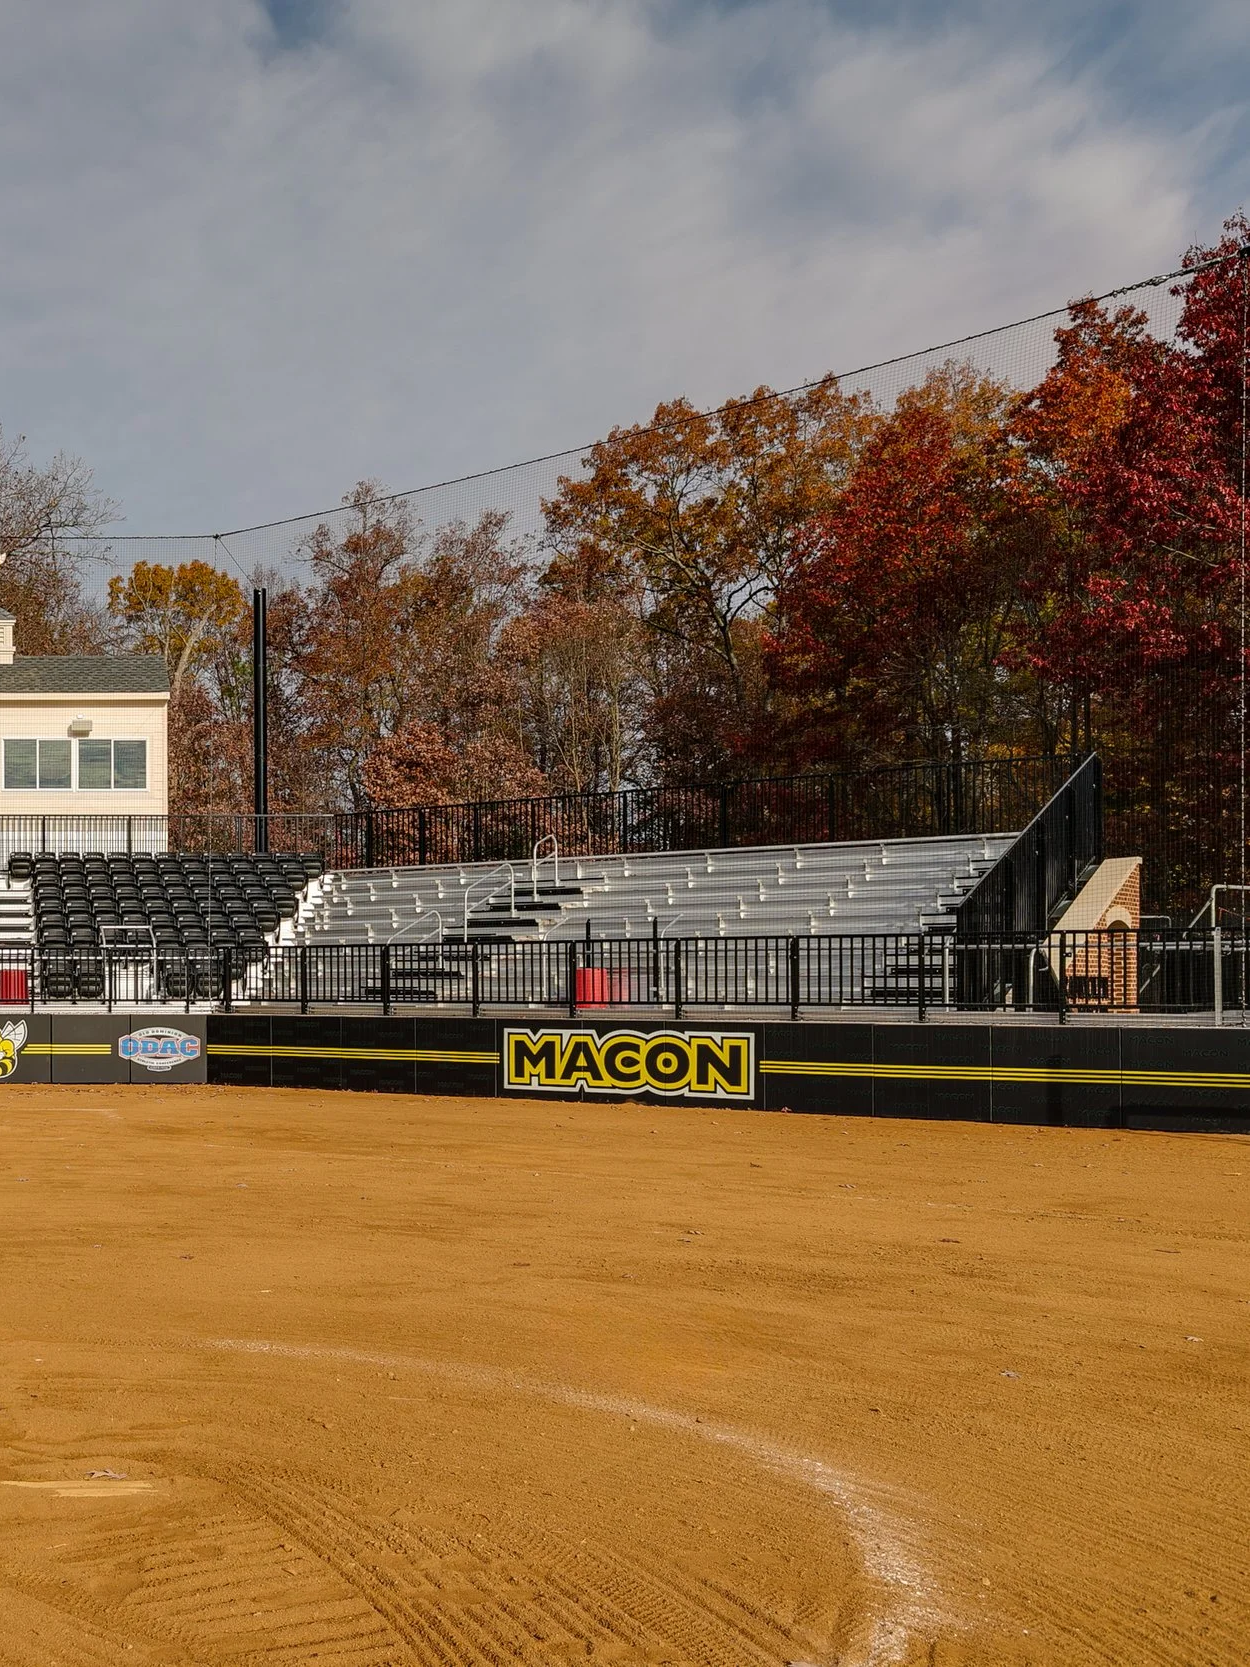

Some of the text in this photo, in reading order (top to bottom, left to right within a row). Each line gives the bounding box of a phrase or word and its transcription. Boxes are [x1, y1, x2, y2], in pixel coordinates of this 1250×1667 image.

[1130, 1035, 1174, 1045] MACON
[120, 1037, 199, 1058] ODAC
[1078, 1047, 1119, 1056] MACON
[1182, 1049, 1230, 1058] MACON
[508, 1034, 748, 1093] MACON
[1129, 1059, 1174, 1069] MACON
[1078, 1087, 1119, 1096] MACON
[1182, 1088, 1230, 1098] MACON
